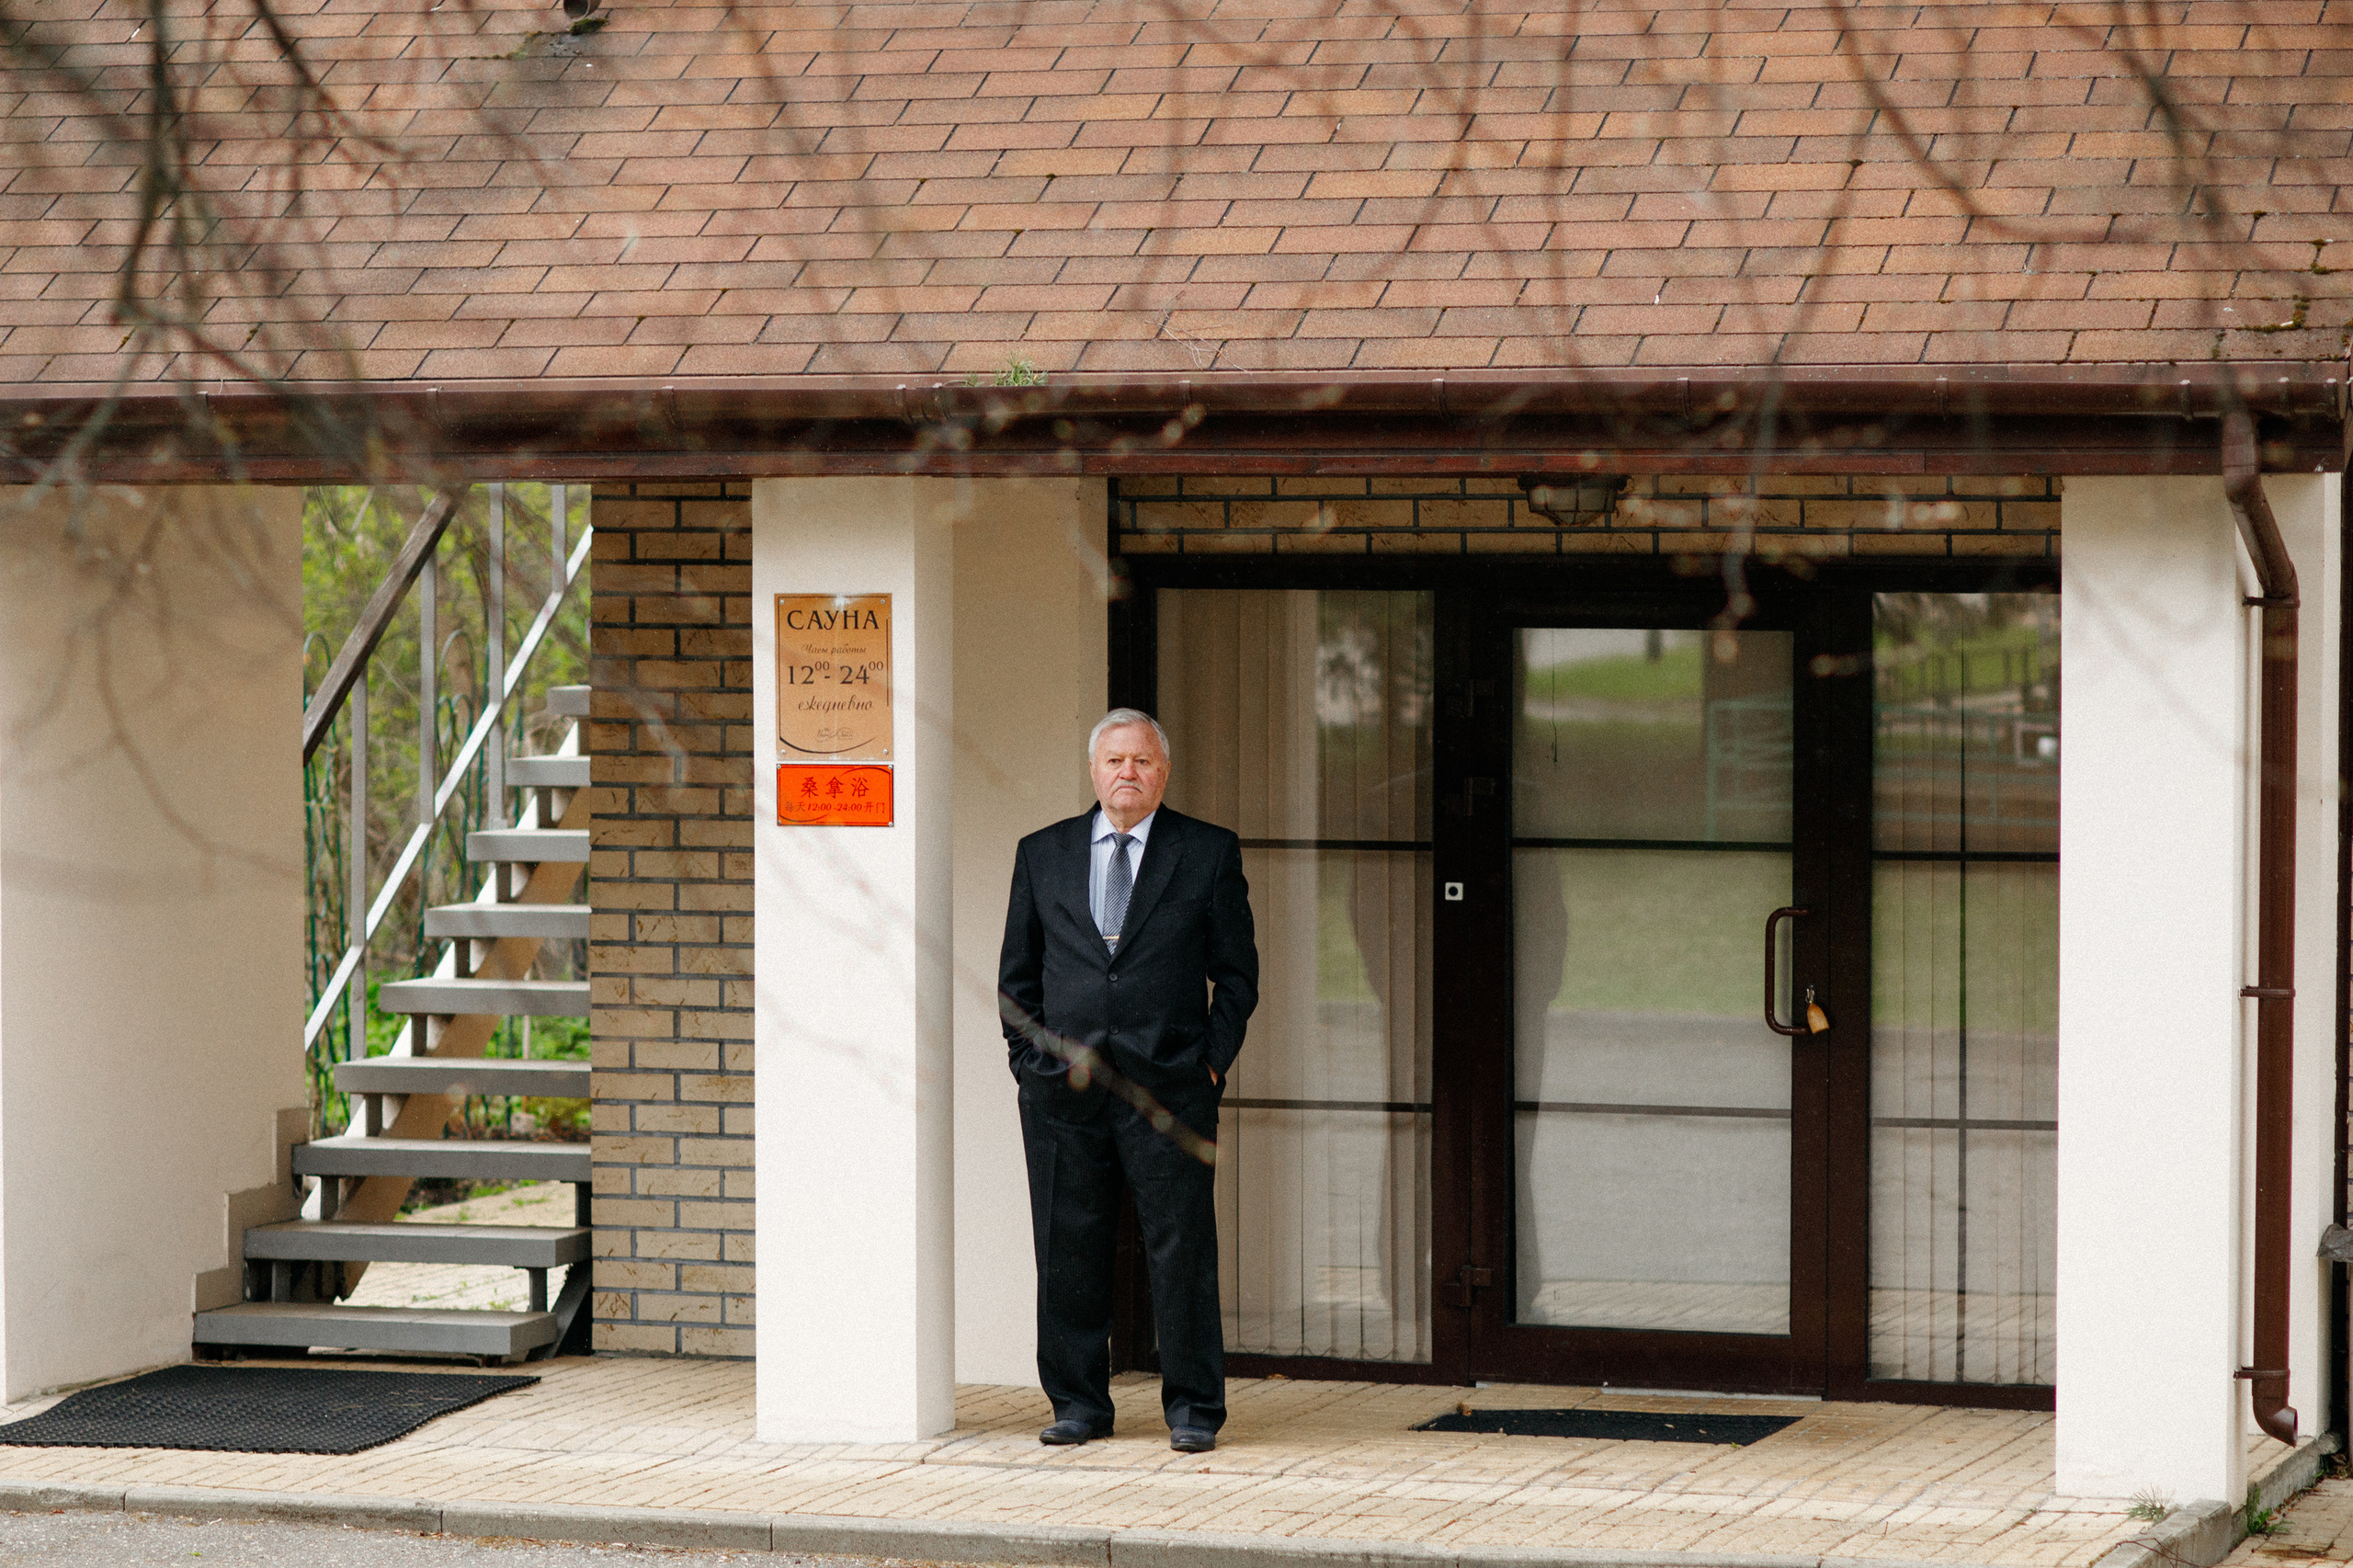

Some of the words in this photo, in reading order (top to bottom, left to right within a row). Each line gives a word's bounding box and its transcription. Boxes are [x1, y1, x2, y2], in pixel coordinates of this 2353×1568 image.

[787, 609, 880, 631] САУНА
[798, 694, 873, 713] ежедневно
[801, 776, 870, 799] 桑拿浴
